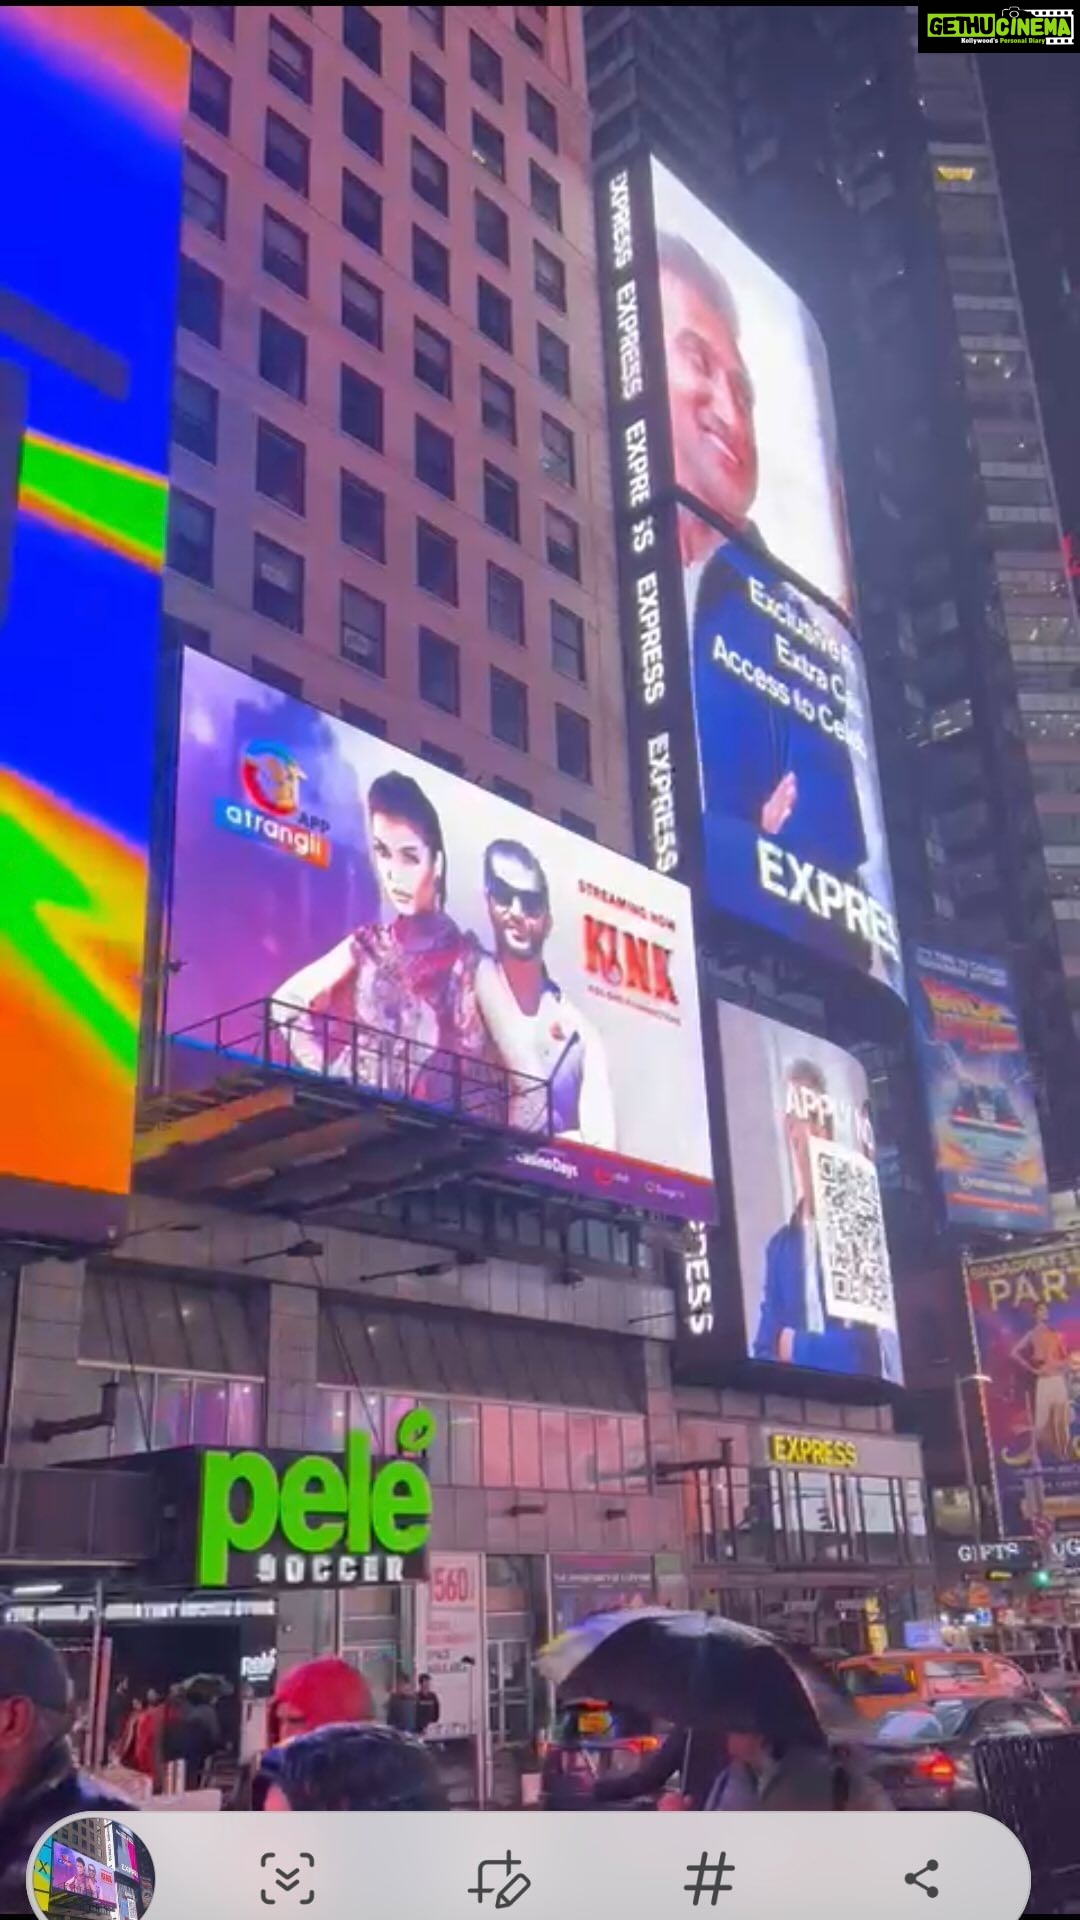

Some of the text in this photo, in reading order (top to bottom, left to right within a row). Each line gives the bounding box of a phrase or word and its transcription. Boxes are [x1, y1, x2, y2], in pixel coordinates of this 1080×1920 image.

[610, 169, 633, 269] EXPRESS
[617, 278, 643, 400] EXPRESS
[637, 571, 665, 704] EXPRESS
[712, 634, 791, 706] Access
[793, 689, 815, 722] to
[775, 632, 830, 691] Extra
[298, 812, 330, 832] APP
[648, 732, 678, 873] EXPRESS
[578, 878, 676, 933] STREAMING NOW
[584, 913, 679, 1005] KINK
[772, 1434, 857, 1468] EXPRESS
[257, 1553, 404, 1583] SOCCER
